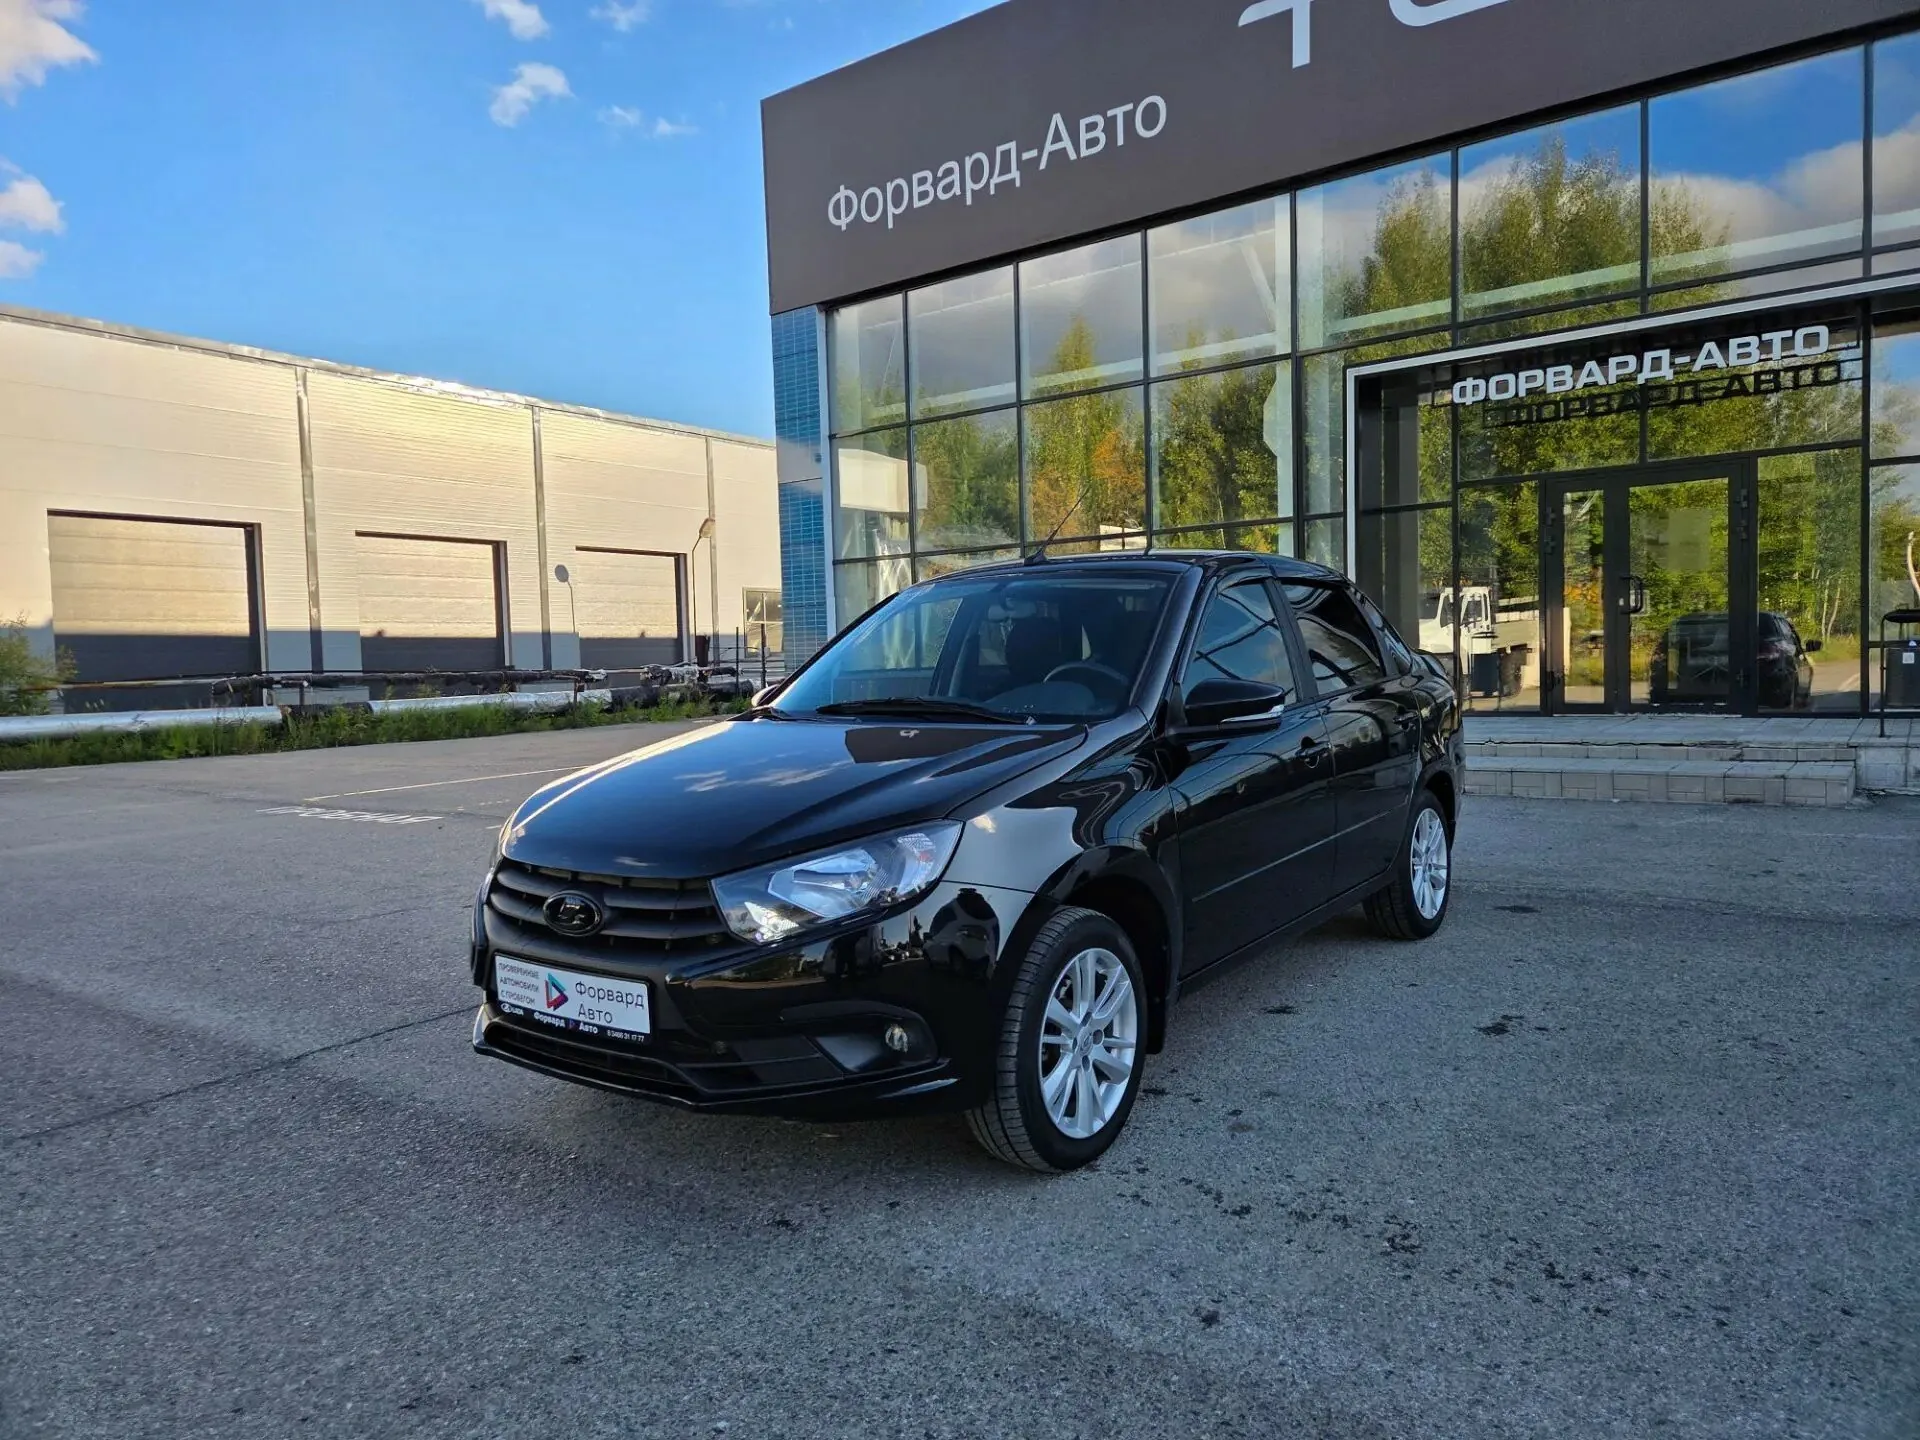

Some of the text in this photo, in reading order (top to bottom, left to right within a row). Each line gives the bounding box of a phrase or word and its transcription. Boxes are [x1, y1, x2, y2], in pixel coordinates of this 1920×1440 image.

[828, 95, 1167, 231] Форвард-Авто
[1452, 325, 1830, 405] ФОРВАРД-АВТО
[575, 980, 645, 1009] Форвард
[533, 1011, 599, 1034] Форвард Авто
[578, 1003, 613, 1024] Авто
